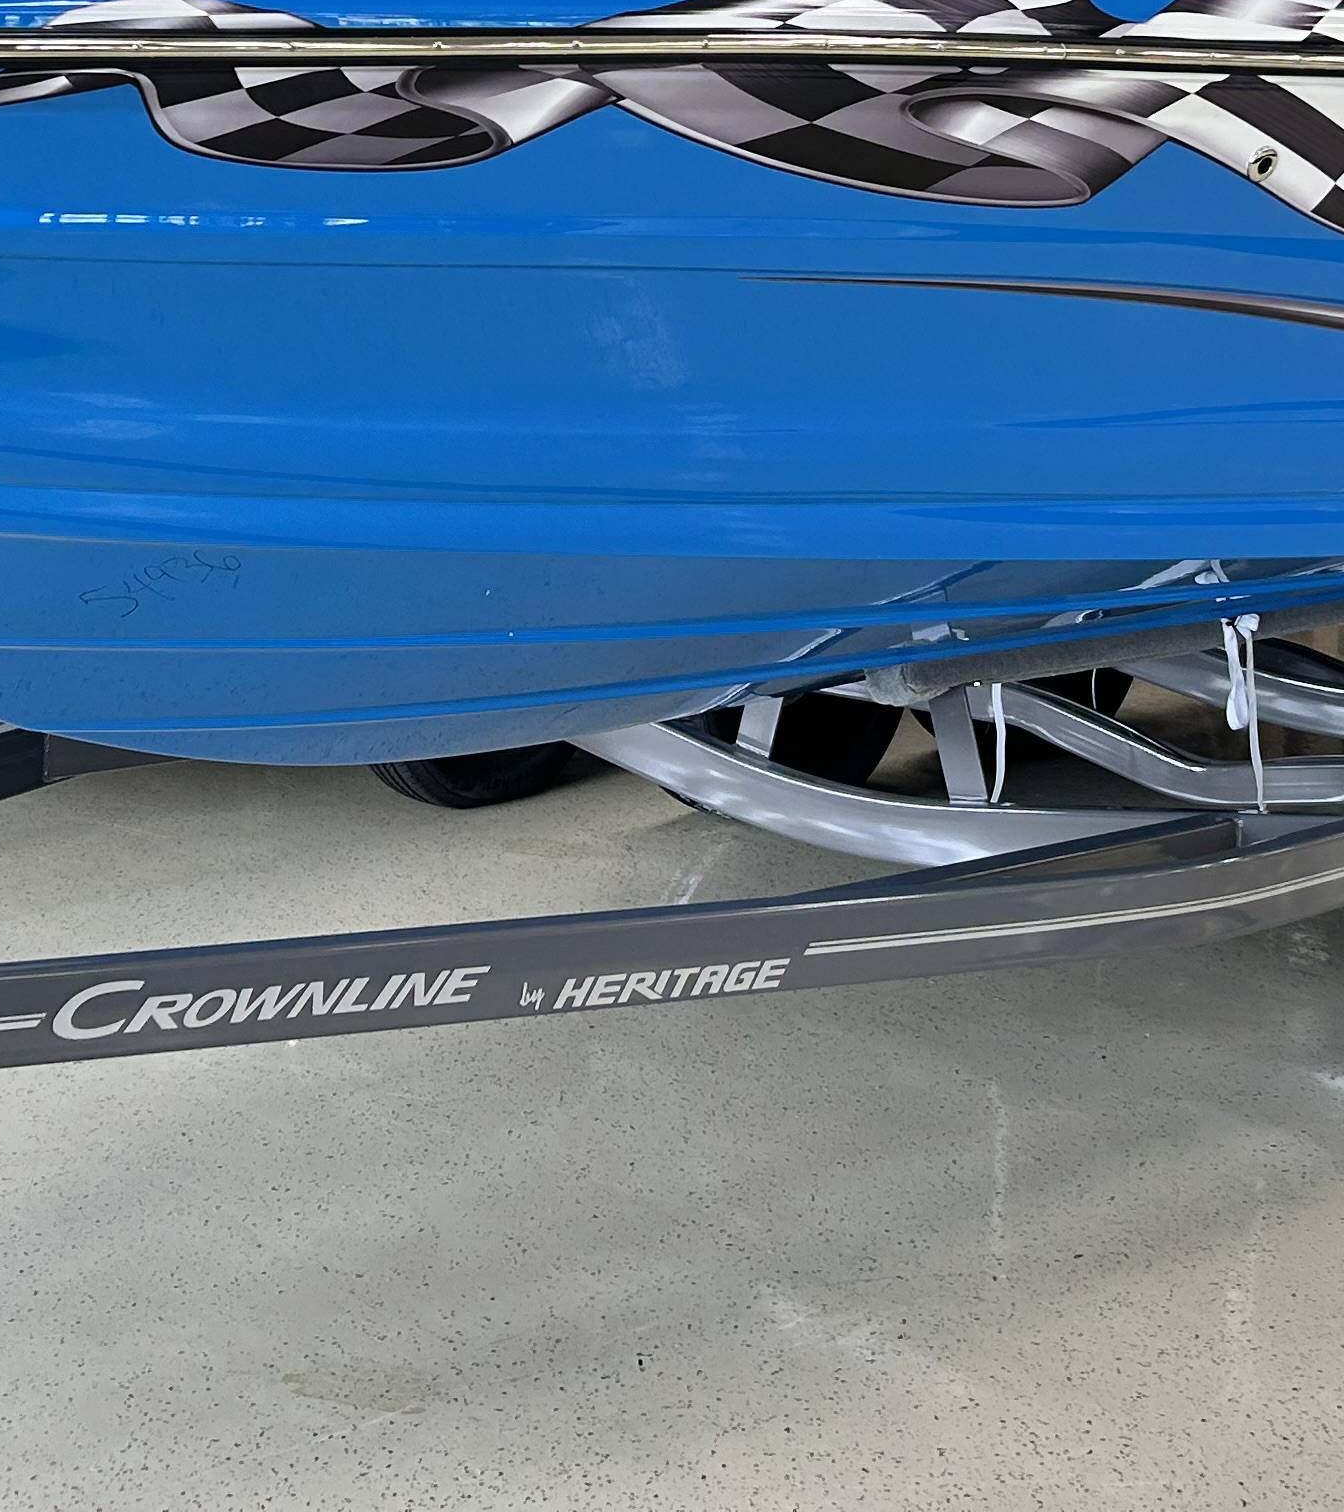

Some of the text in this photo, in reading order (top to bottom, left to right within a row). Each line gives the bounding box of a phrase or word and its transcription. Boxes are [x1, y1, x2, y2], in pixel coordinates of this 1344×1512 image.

[52, 958, 792, 1041] CROWNLINE by HERITAGE
